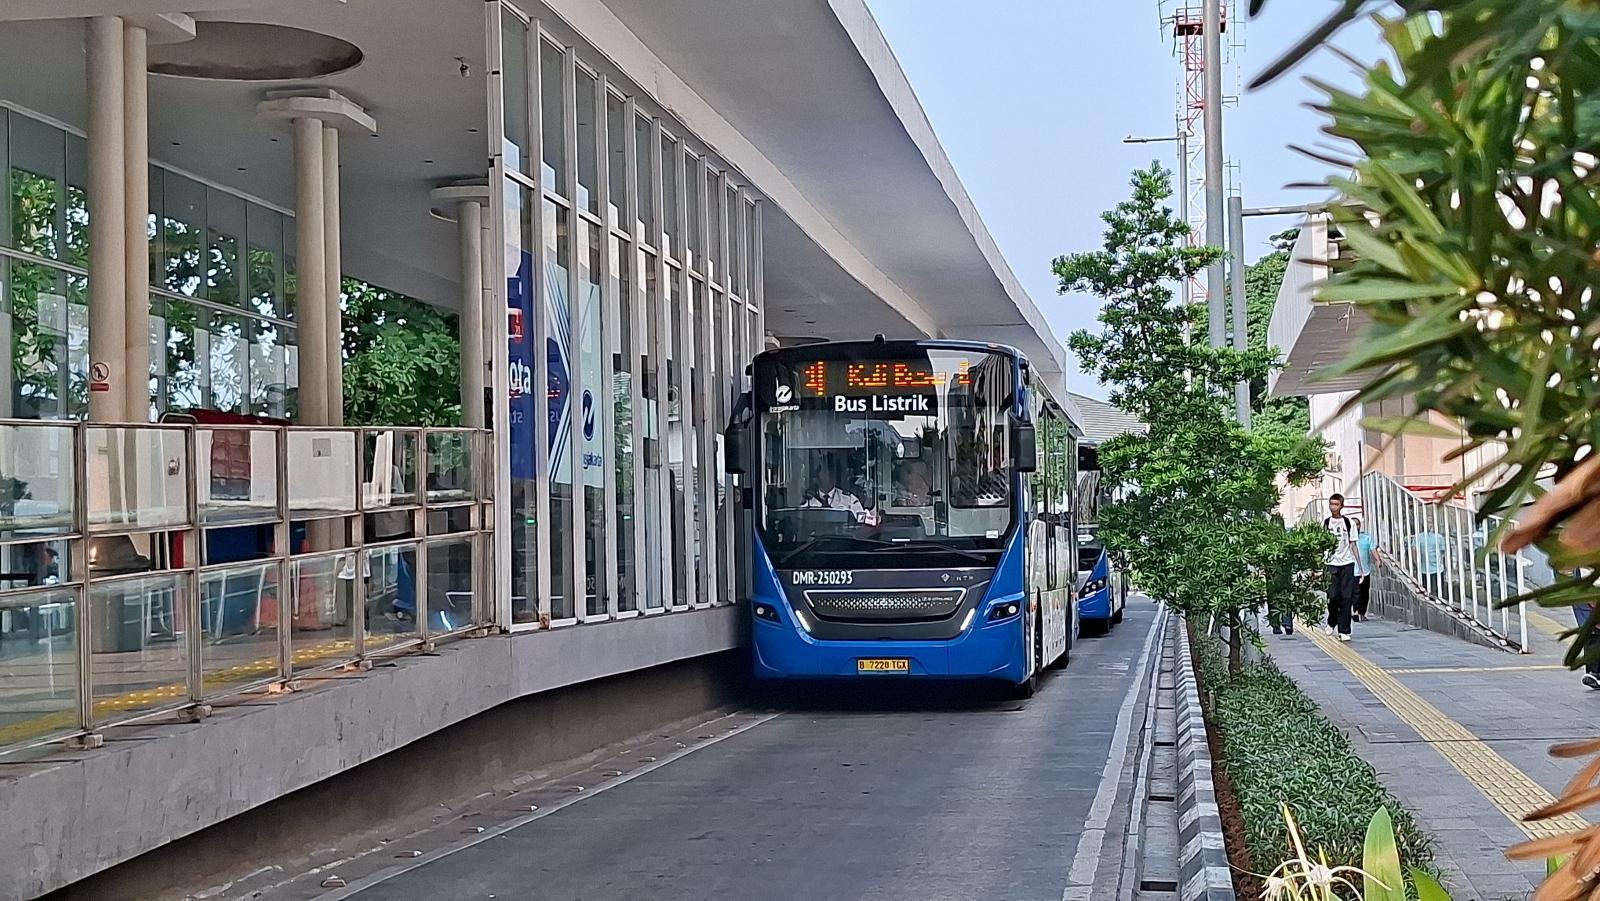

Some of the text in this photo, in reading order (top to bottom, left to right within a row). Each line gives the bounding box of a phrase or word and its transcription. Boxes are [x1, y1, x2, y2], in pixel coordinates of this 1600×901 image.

[509, 358, 531, 395] ota
[834, 394, 929, 412] Bus Listrik
[792, 570, 853, 585] DMR-250293
